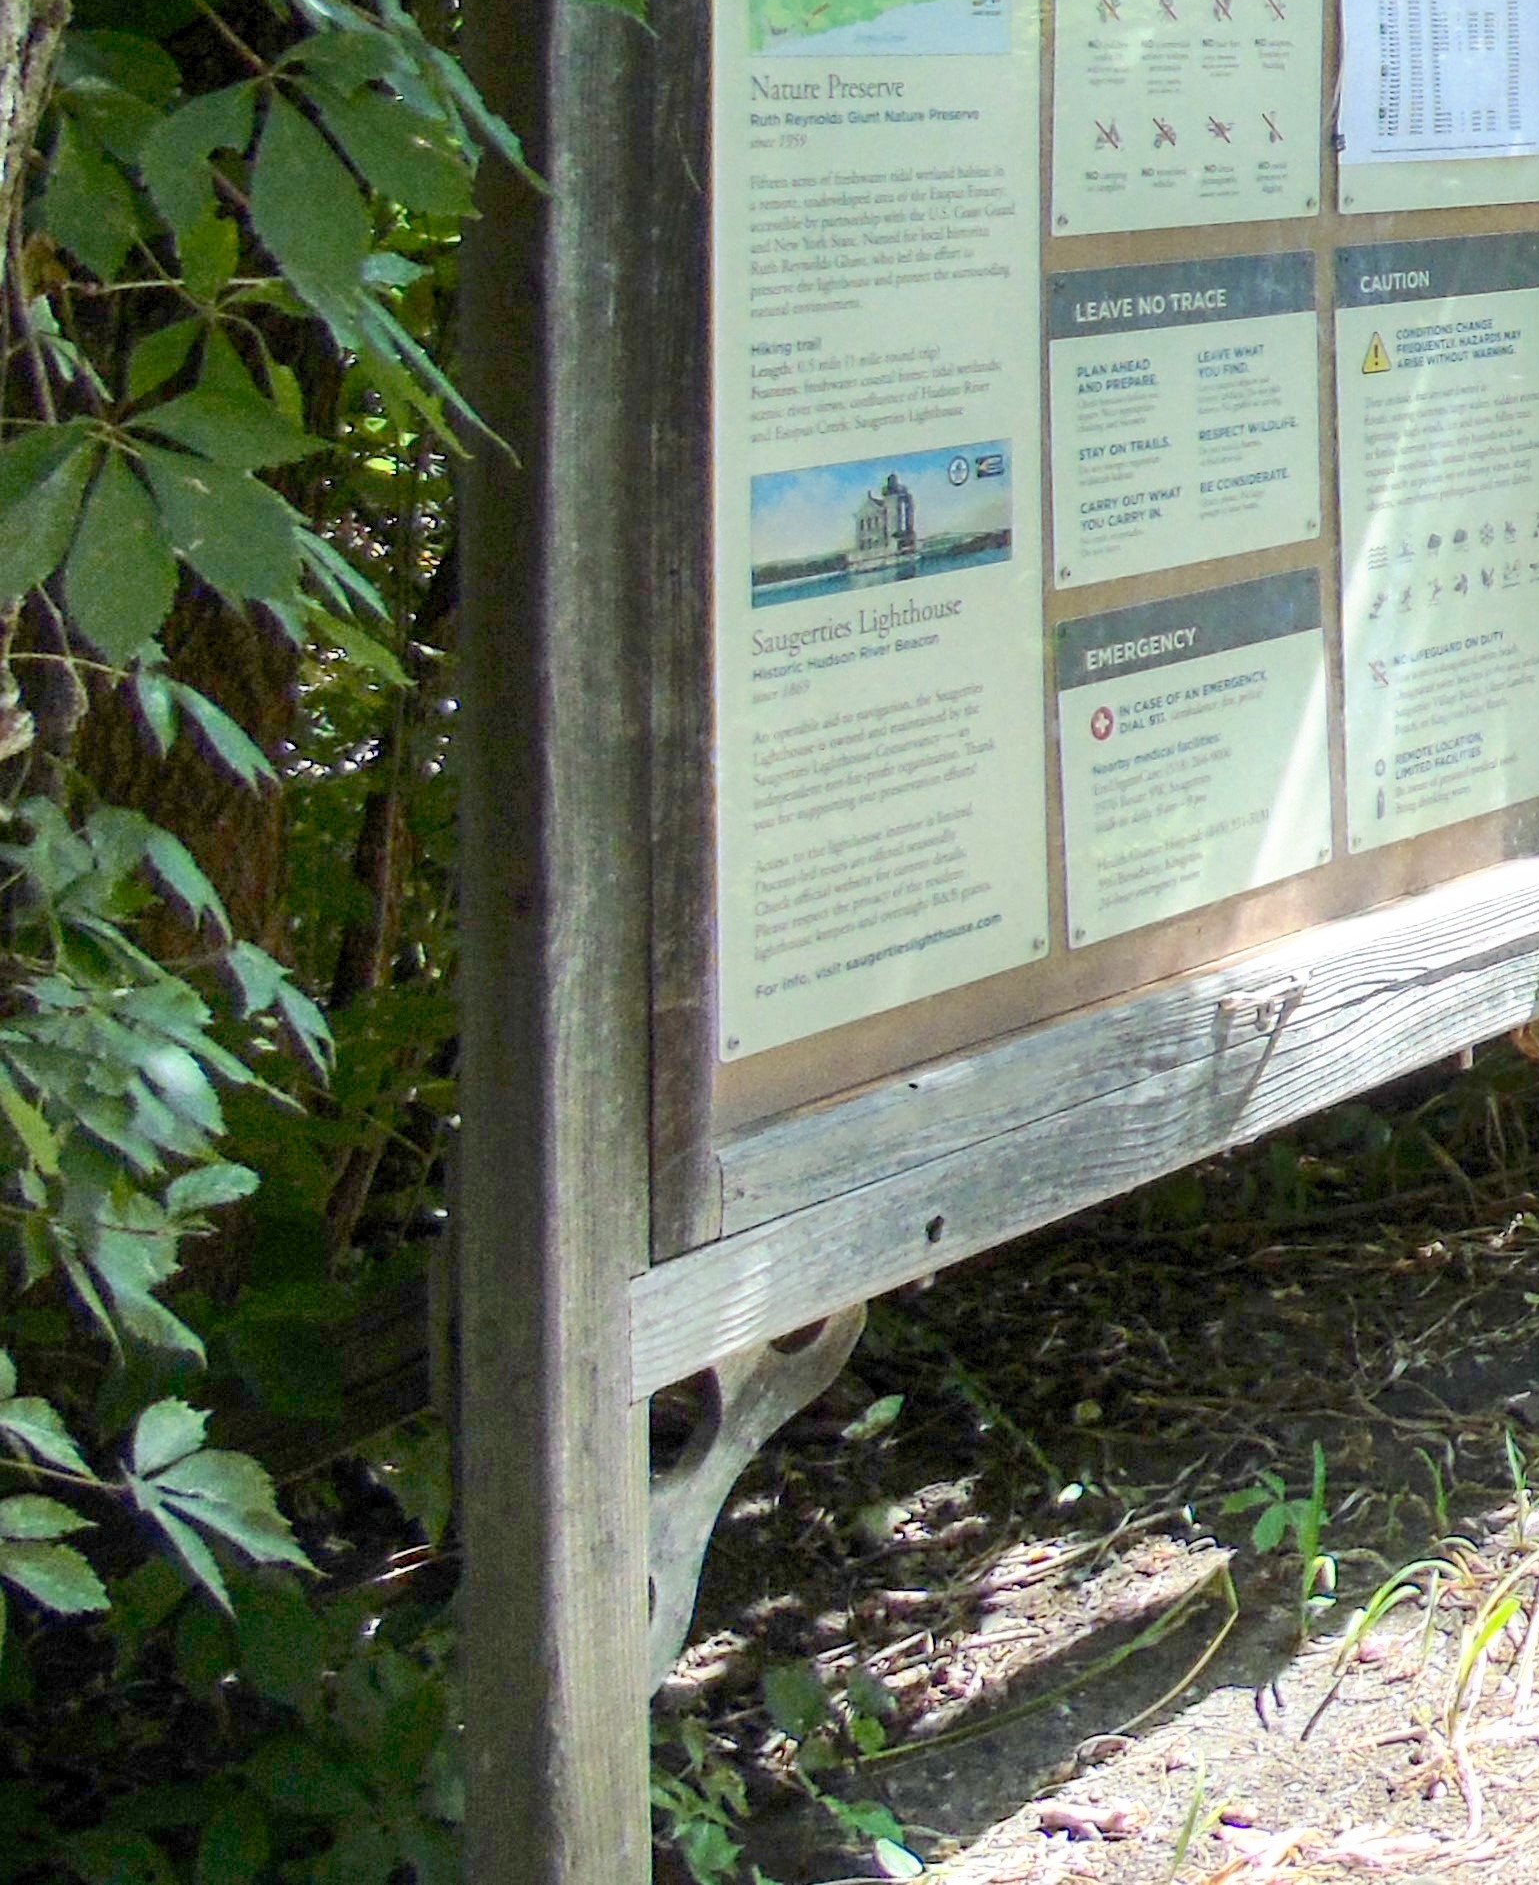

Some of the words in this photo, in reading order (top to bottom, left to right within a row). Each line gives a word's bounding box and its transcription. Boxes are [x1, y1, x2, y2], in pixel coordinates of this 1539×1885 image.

[751, 75, 820, 101] Nature
[828, 74, 905, 99] Preserve
[751, 113, 781, 126] Ruth
[785, 112, 843, 126] Reynolds
[847, 111, 880, 123] Glunt
[885, 110, 925, 122] Nature
[929, 109, 979, 121] Preserve
[1360, 270, 1430, 293] CAUTION
[1076, 298, 1133, 323] LEAVE
[1137, 296, 1166, 314] NO
[1171, 289, 1227, 310] TRACE
[1197, 348, 1231, 363] LEAVE
[1234, 345, 1265, 358] WHAT
[1077, 365, 1108, 378] PLAN
[1111, 359, 1151, 373] AHEAD
[1198, 366, 1221, 379] YOU
[1078, 381, 1103, 395] AND
[1199, 425, 1245, 441] RESPECT
[1079, 447, 1105, 461] STAY
[1109, 442, 1127, 455] ON
[1200, 481, 1214, 493] BE
[1080, 497, 1118, 514] CARRY
[1123, 492, 1145, 507] OUT
[1150, 486, 1182, 502] WHAT
[1081, 516, 1105, 531] YOU
[1108, 511, 1145, 527] CARRY
[751, 618, 852, 657] Saugerties
[859, 598, 963, 638] Lighthouse
[752, 661, 804, 681] Historic
[808, 650, 856, 671] Hudson
[860, 644, 891, 659] River
[895, 633, 940, 652] Beacon
[1086, 627, 1196, 670] EMERGENCY
[1119, 704, 1131, 717] IN
[1133, 698, 1164, 715] CASE
[1166, 693, 1181, 705] OF
[1185, 687, 1200, 701] AN
[1120, 720, 1145, 735] DIAL
[755, 981, 780, 998] For
